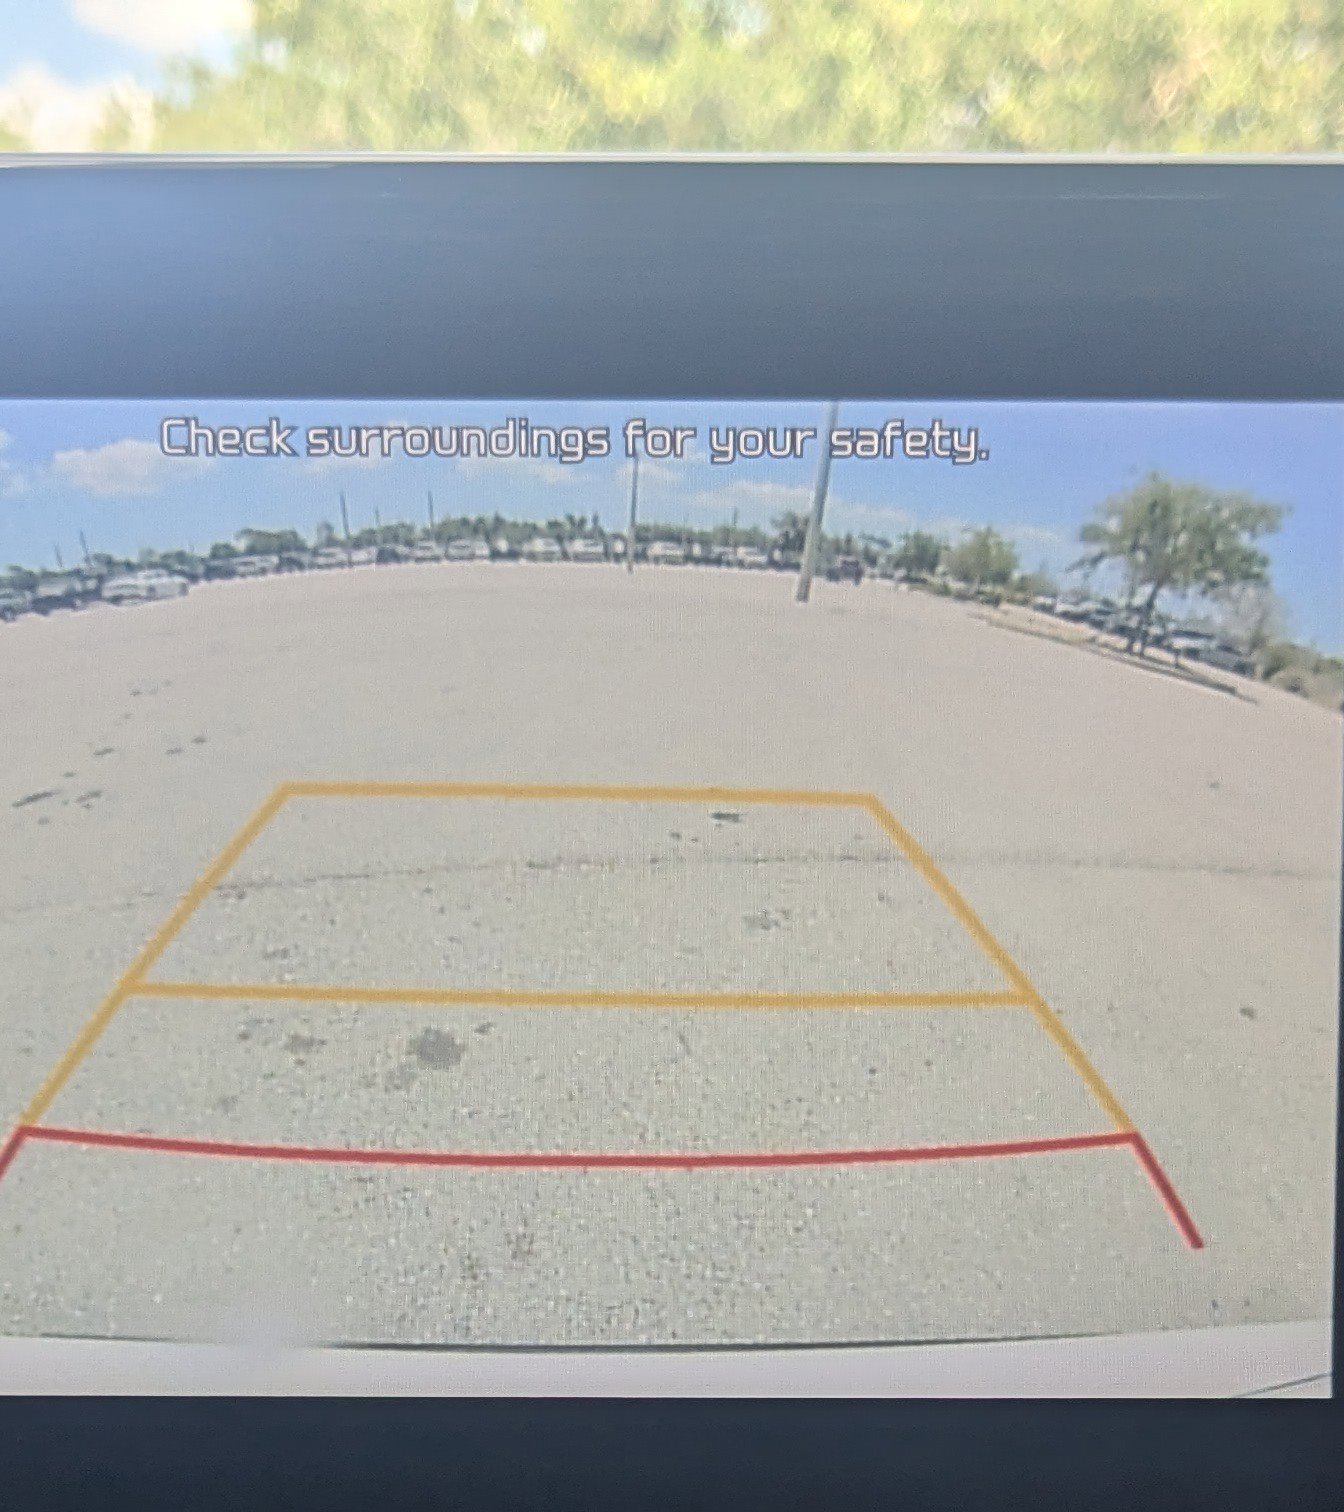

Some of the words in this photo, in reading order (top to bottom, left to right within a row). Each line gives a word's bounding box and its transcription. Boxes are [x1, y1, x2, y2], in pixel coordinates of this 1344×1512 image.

[160, 416, 299, 457] Check
[306, 417, 611, 464] surroundings
[624, 418, 696, 458] for
[710, 428, 816, 464] your
[829, 418, 990, 465] safety.
